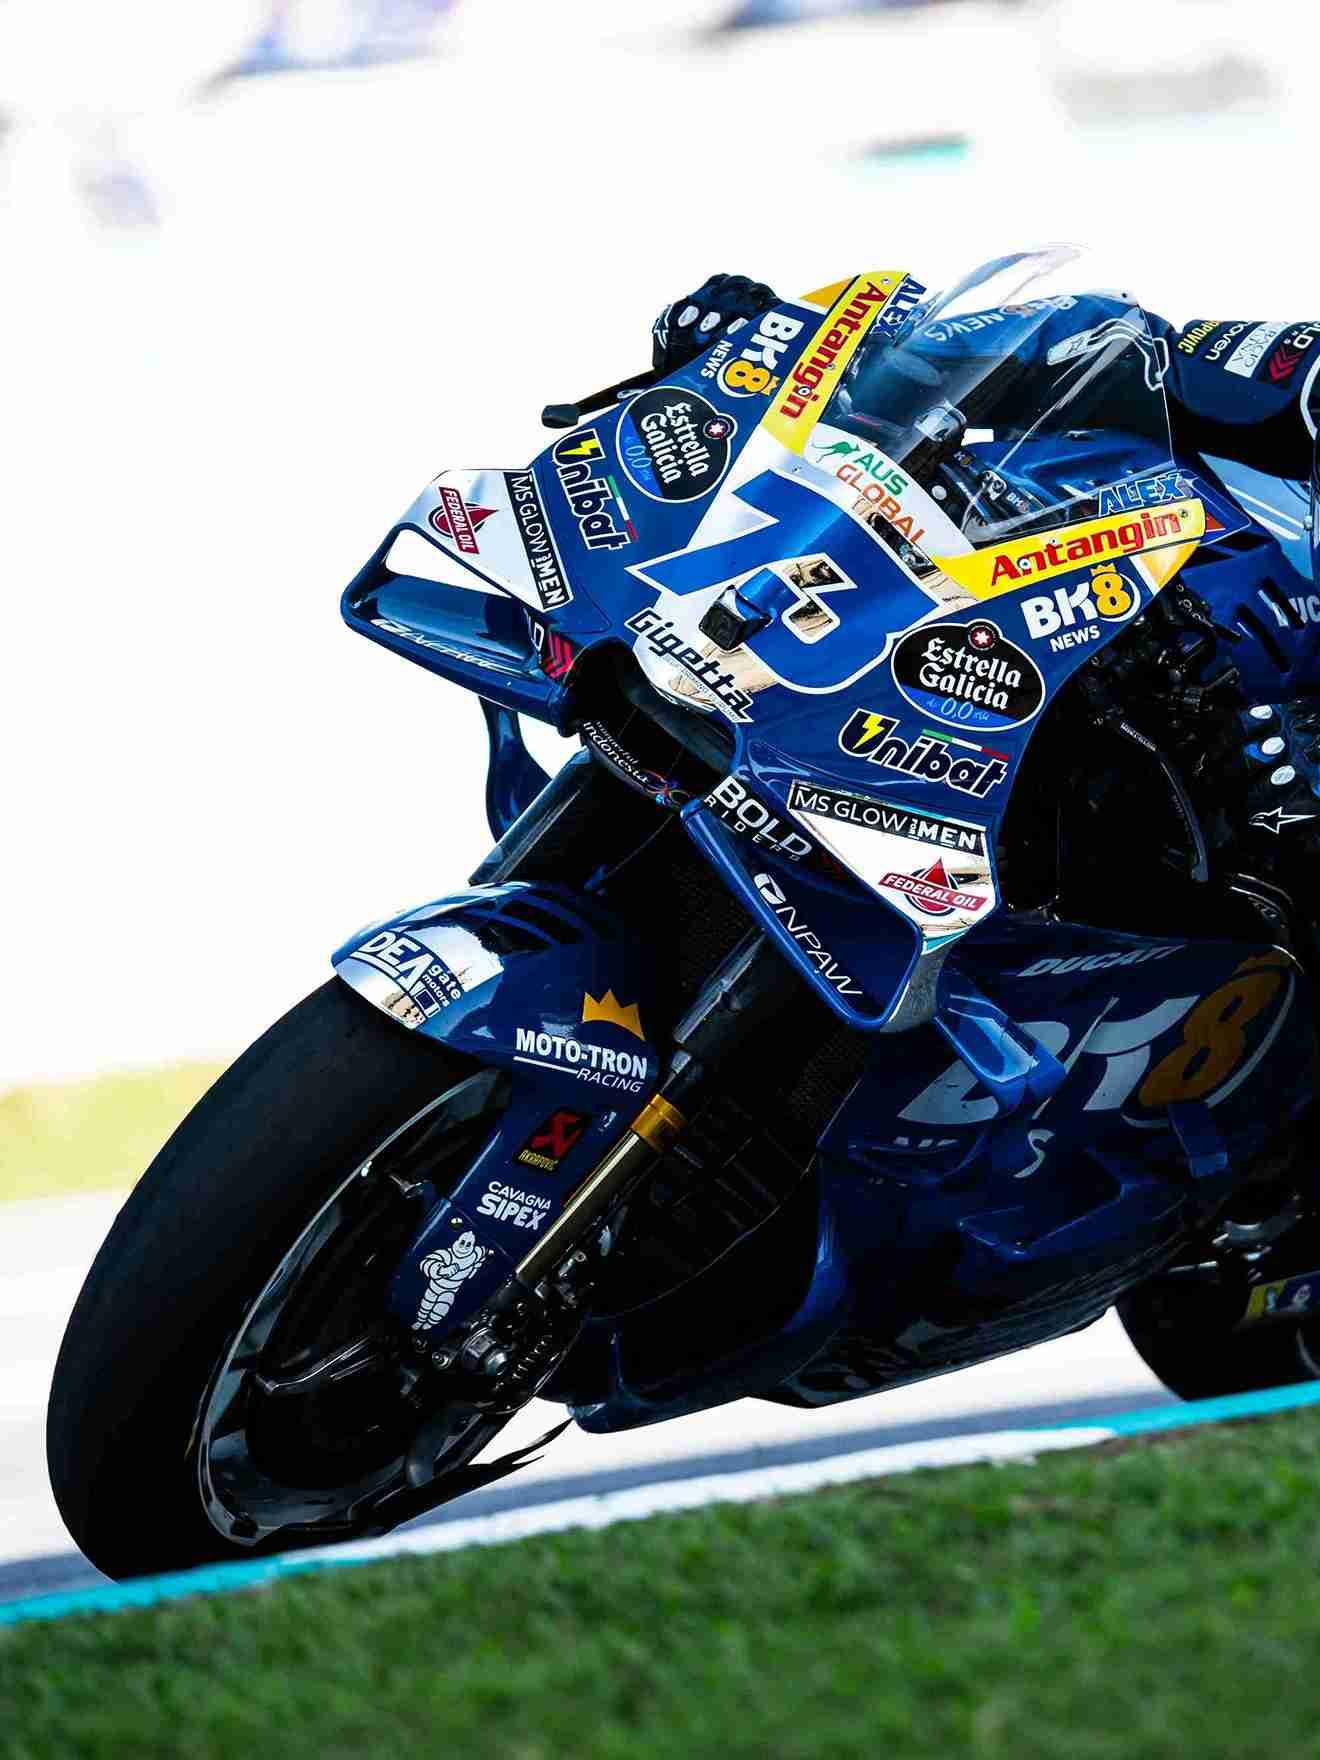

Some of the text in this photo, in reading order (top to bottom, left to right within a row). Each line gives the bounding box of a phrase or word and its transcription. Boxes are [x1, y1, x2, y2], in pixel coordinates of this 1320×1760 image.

[701, 339, 733, 380] NEWS
[780, 281, 888, 420] Antangin
[1204, 322, 1250, 361] oven
[640, 415, 682, 485] Galicia
[666, 401, 711, 478] Estrella
[511, 475, 533, 501] MS
[553, 429, 631, 551] Unibat
[853, 453, 908, 495] AUS
[1100, 472, 1186, 516] ALEX
[458, 535, 476, 550] OIL
[519, 503, 549, 553] GLOW
[990, 512, 1182, 586] Antangin
[536, 560, 565, 608] MEN
[1021, 568, 1133, 640] BK8
[921, 637, 1021, 687] Estrella
[1050, 625, 1101, 653] NEWS
[627, 610, 751, 719] Gigetta
[919, 662, 1009, 710] Galicia
[838, 709, 1009, 798] Unibat
[712, 776, 813, 856] BOLD
[795, 789, 828, 812] MS
[834, 801, 907, 832] GLOW
[918, 821, 976, 850] MEN
[884, 874, 978, 908] FEDERAL OIL
[776, 907, 863, 994] NPAW
[422, 975, 450, 1006] motors
[429, 965, 461, 999] gate
[516, 1028, 647, 1079] MOTO-TRON
[576, 1068, 644, 1093] RACING
[476, 1193, 547, 1230] SIPEX
[488, 1181, 551, 1209] CAVAGNA
